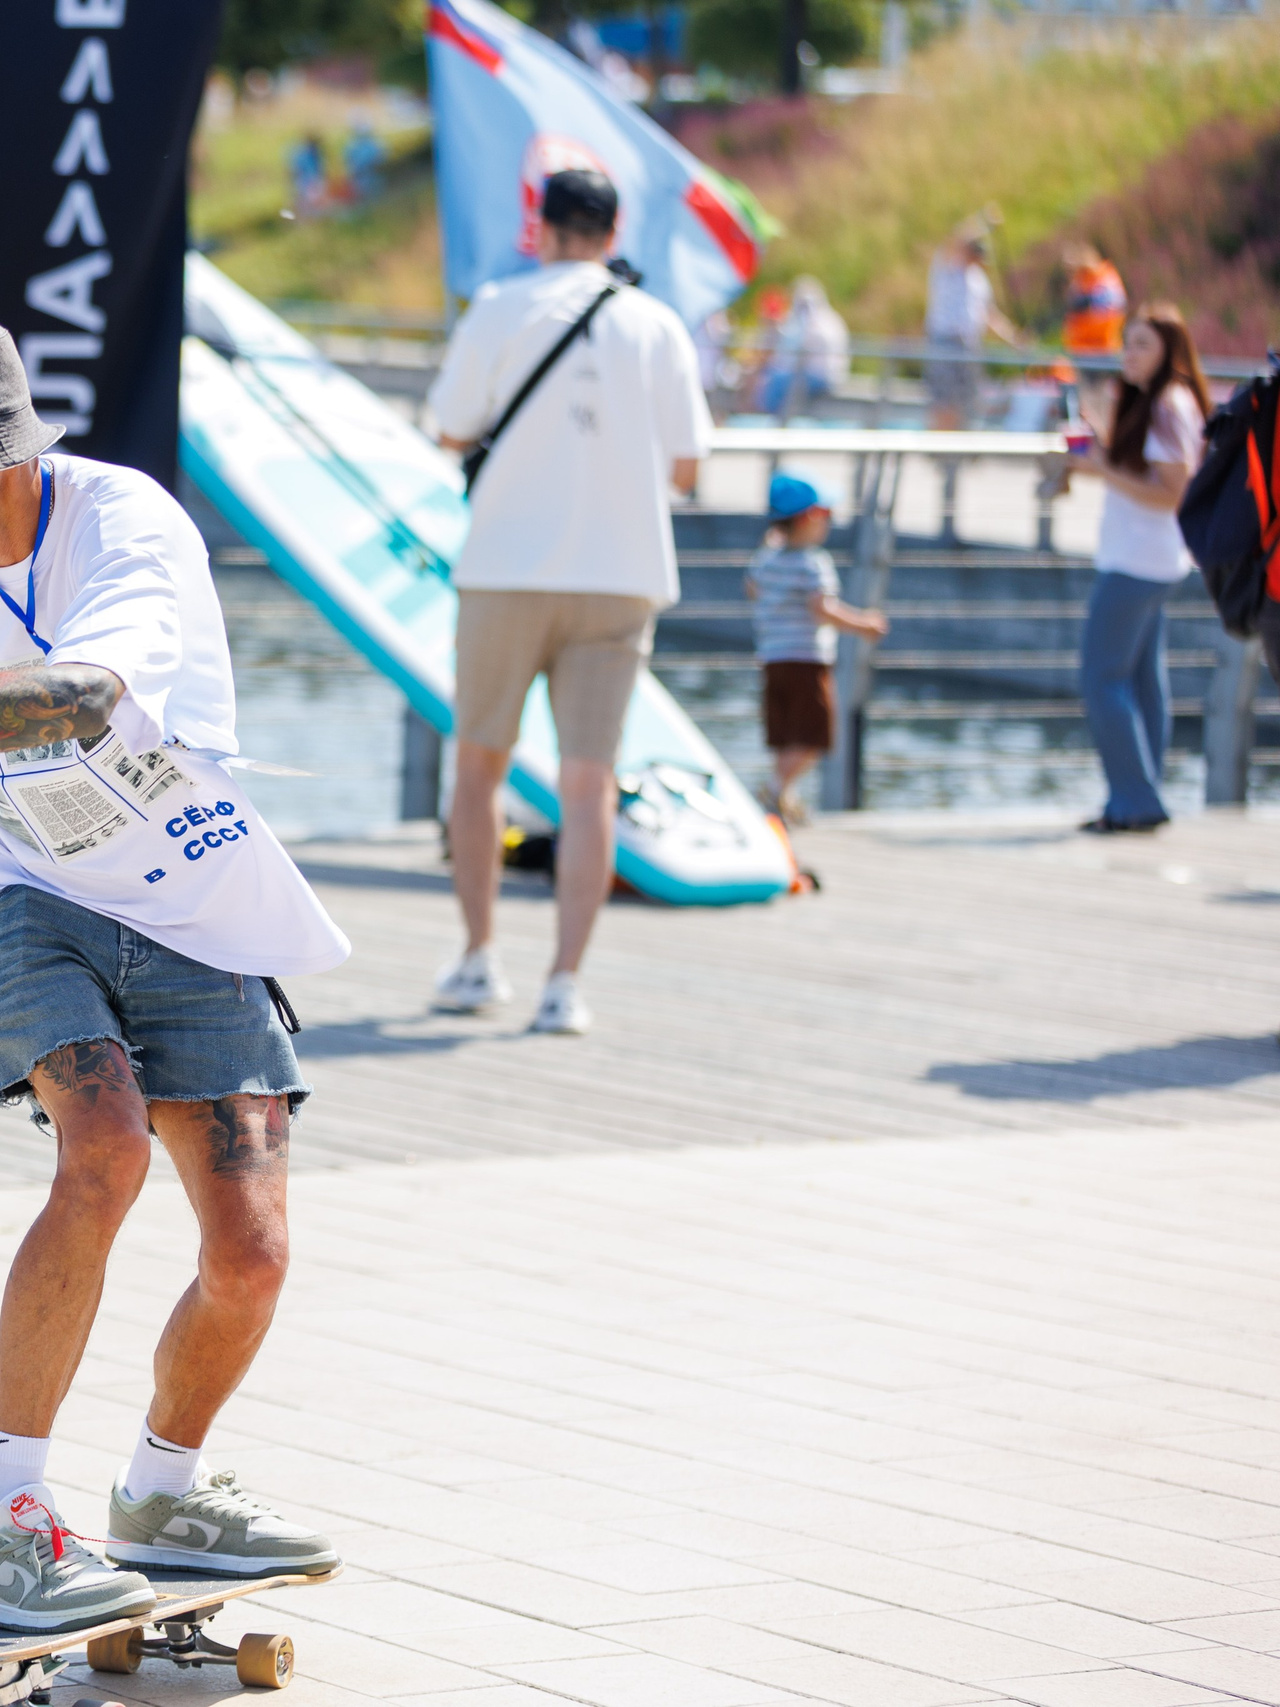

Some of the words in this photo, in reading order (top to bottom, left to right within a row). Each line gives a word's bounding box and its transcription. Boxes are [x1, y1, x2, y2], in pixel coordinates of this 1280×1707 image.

[143, 868, 167, 884] В
[12, 1493, 27, 1504] NIKE
[27, 1498, 35, 1506] SB
